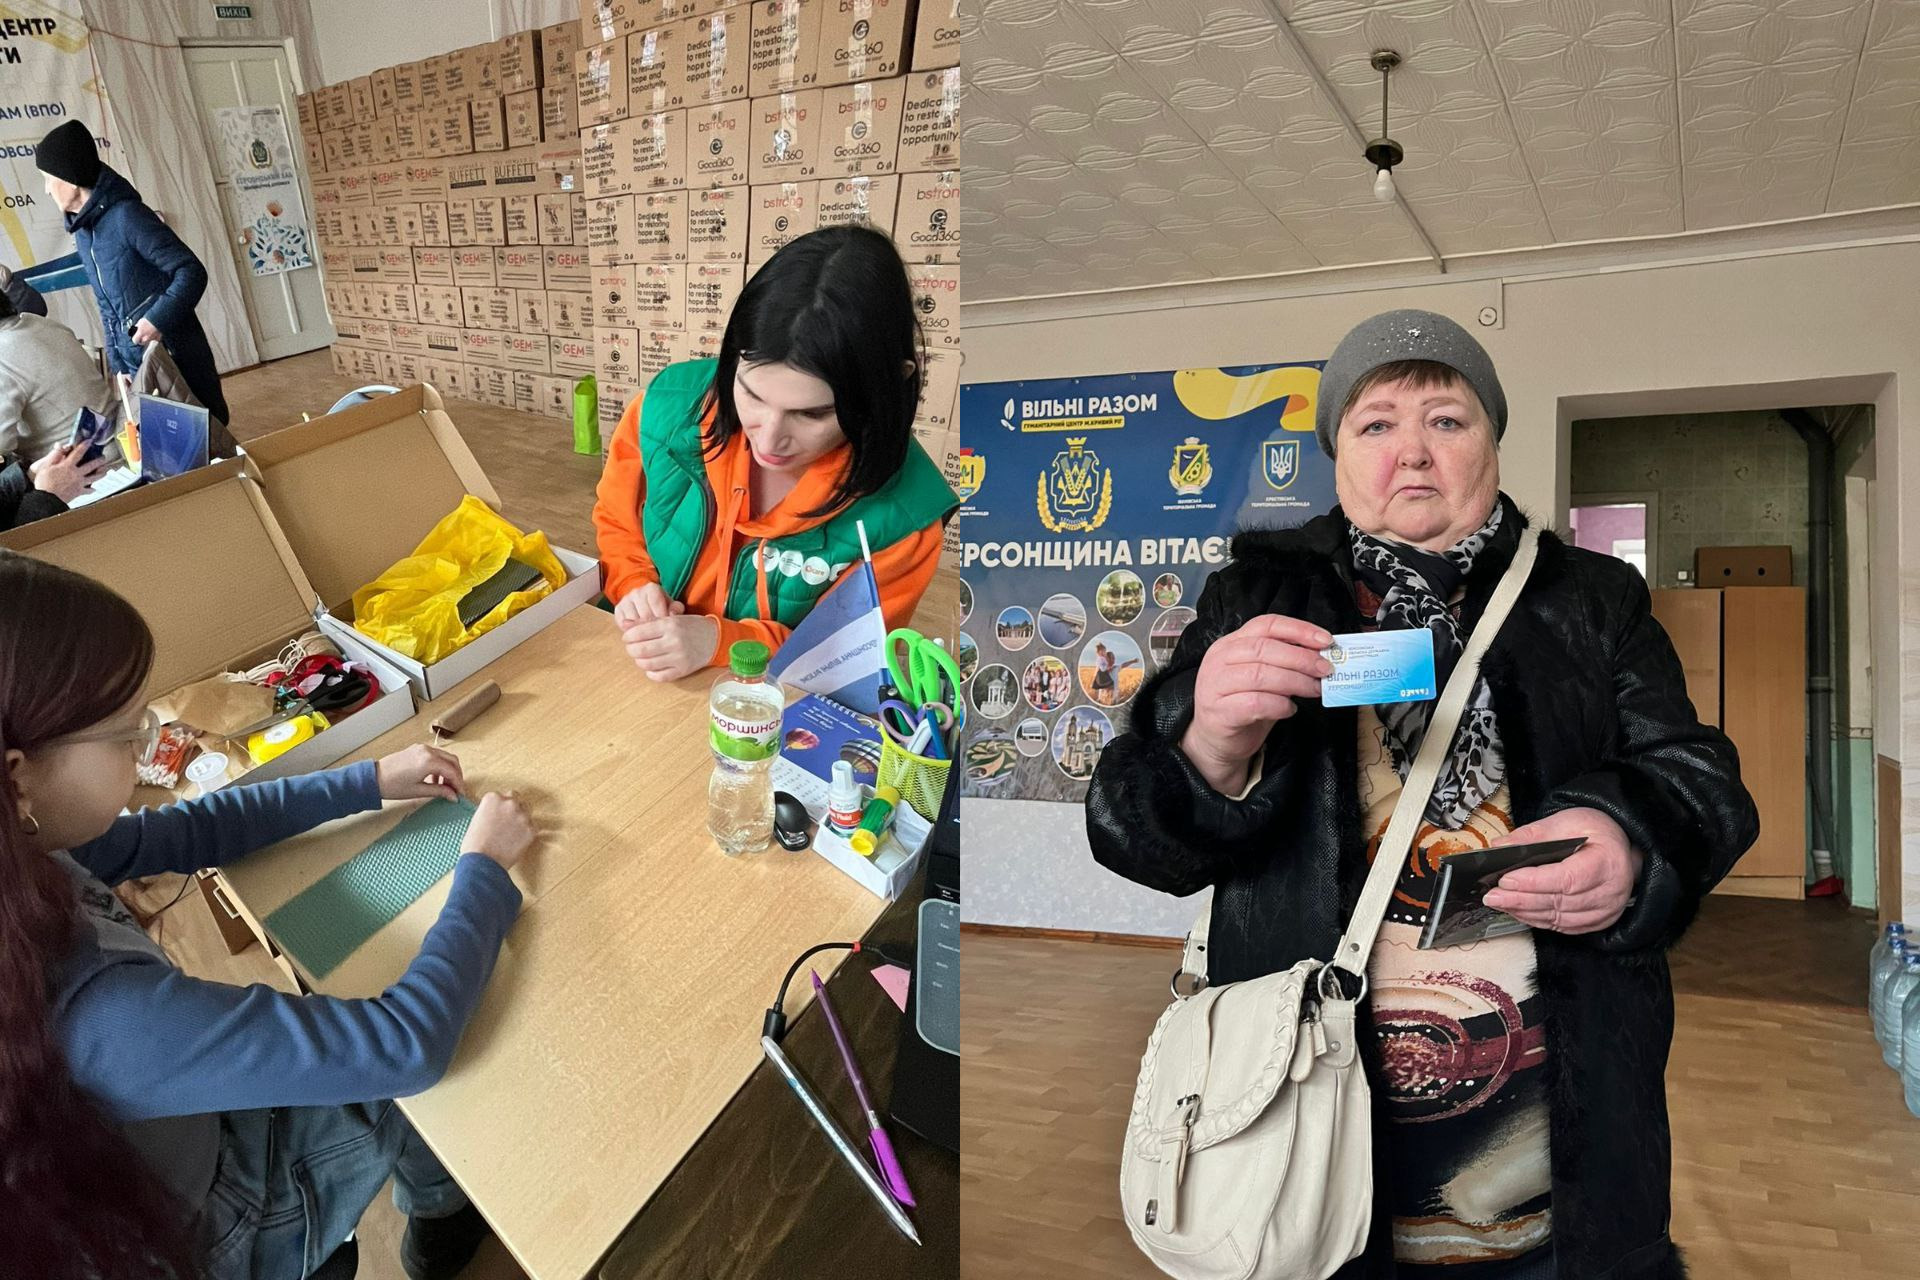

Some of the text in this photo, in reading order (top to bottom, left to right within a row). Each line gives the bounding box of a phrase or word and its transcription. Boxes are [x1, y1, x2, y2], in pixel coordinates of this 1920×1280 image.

[219, 6, 249, 17] ВИХІД
[934, 28, 960, 41] Goo
[753, 41, 761, 49] to
[687, 53, 693, 61] to
[753, 48, 773, 60] hope
[687, 62, 705, 72] hope
[632, 71, 661, 85] hope and
[25, 101, 66, 119] (ВПО)
[905, 113, 914, 122] to
[698, 118, 735, 132] bstrong
[904, 120, 951, 134] hope and
[834, 142, 880, 157] Good360
[634, 156, 648, 164] hope
[698, 156, 734, 169] Good360
[494, 162, 536, 178] BUFFETT
[4, 194, 36, 208] ОВА
[820, 213, 828, 222] to
[690, 227, 706, 235] hope
[462, 254, 480, 263] GEM
[507, 254, 526, 264] GEM
[557, 254, 579, 265] GEM
[688, 299, 703, 307] hope
[470, 335, 488, 344] GEM
[513, 340, 532, 349] GEM
[563, 344, 585, 355] GEM
[1022, 393, 1157, 418] ВІЛЬНІ РАЗОМ
[1066, 420, 1083, 428] ЦЕНТР
[947, 452, 960, 461] De
[944, 469, 960, 479] hop
[1363, 669, 1400, 679] РАЗОМ
